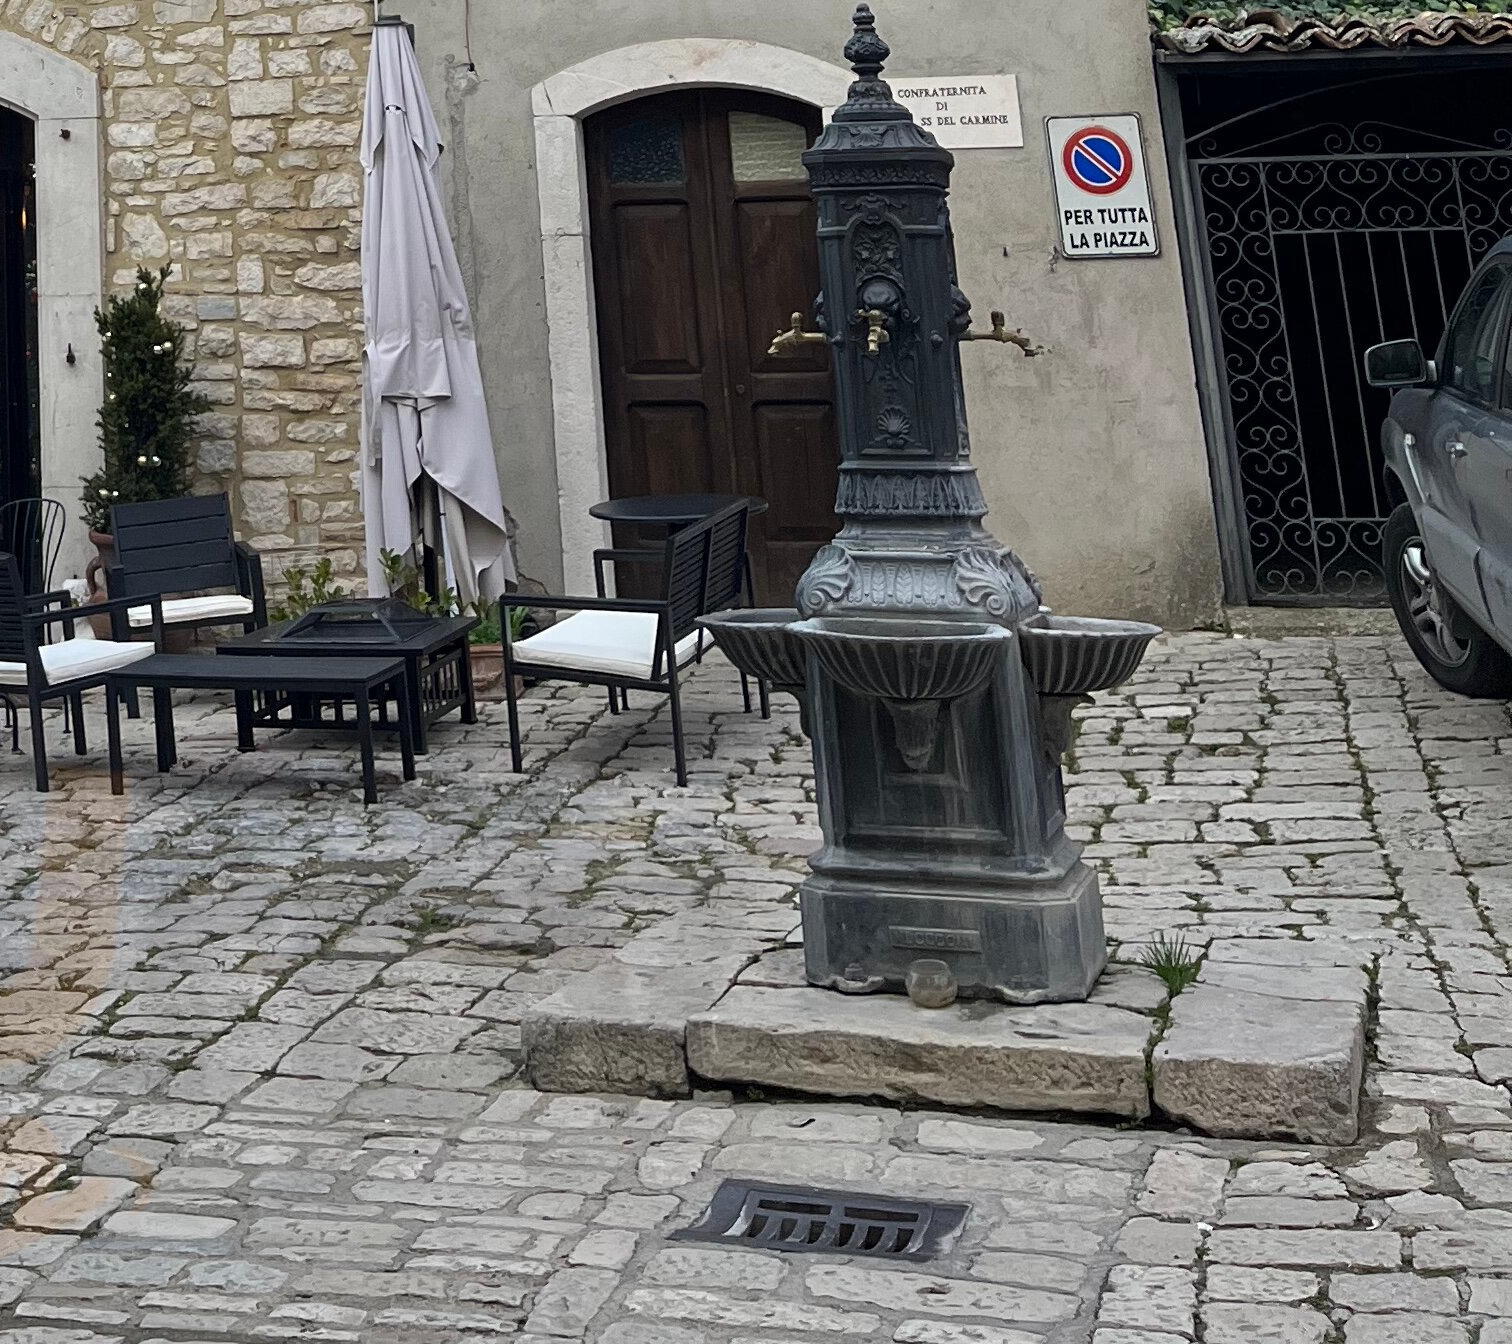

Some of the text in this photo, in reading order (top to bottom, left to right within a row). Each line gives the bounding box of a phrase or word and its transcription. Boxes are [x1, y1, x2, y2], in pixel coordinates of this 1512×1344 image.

[897, 86, 987, 99] CONFRATERNITA
[936, 101, 948, 112] DI
[920, 114, 1009, 126] SS DEL CARMINE
[1064, 207, 1149, 226] PER TUTTA
[1069, 231, 1150, 250] LA PIAZZA
